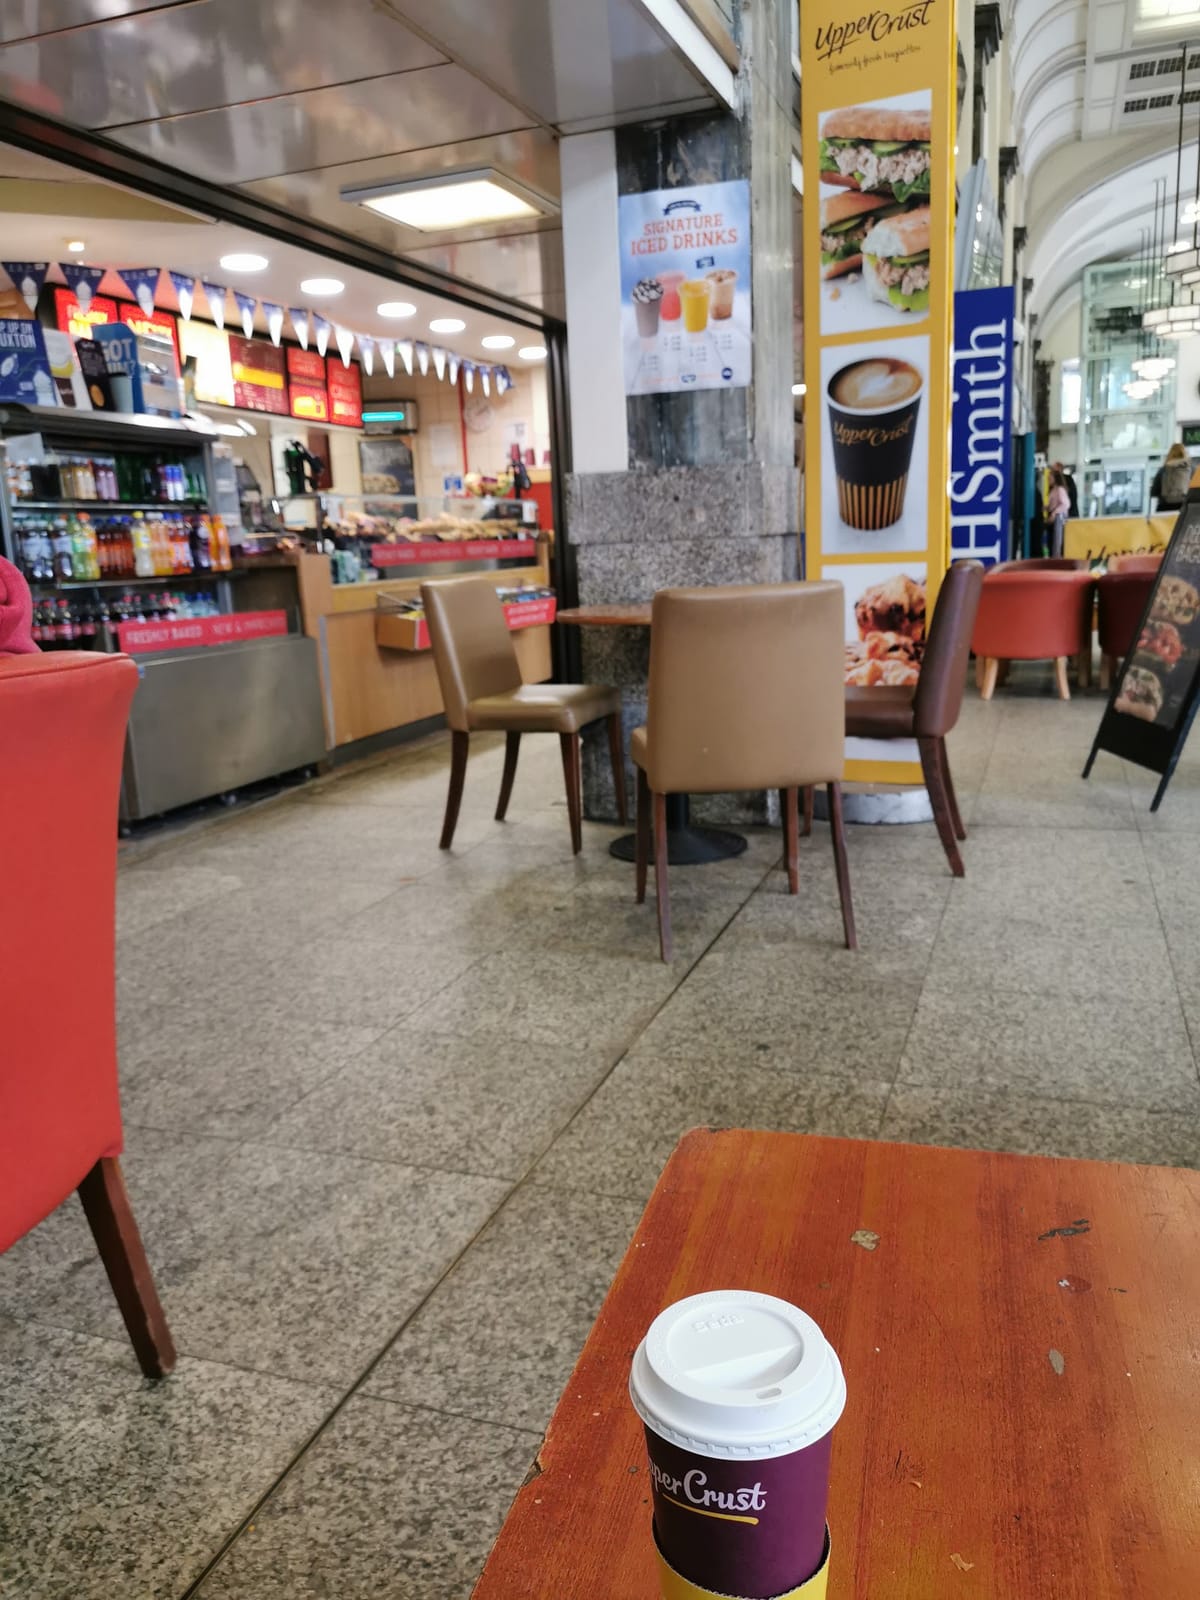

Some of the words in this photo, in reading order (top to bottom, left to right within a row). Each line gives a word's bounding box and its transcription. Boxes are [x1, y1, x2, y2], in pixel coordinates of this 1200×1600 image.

[643, 215, 722, 236] SIGNATURE
[630, 236, 668, 256] ICED
[673, 228, 738, 251] DRINKS
[125, 628, 169, 644] FRESHLY
[171, 624, 203, 640] BAKED
